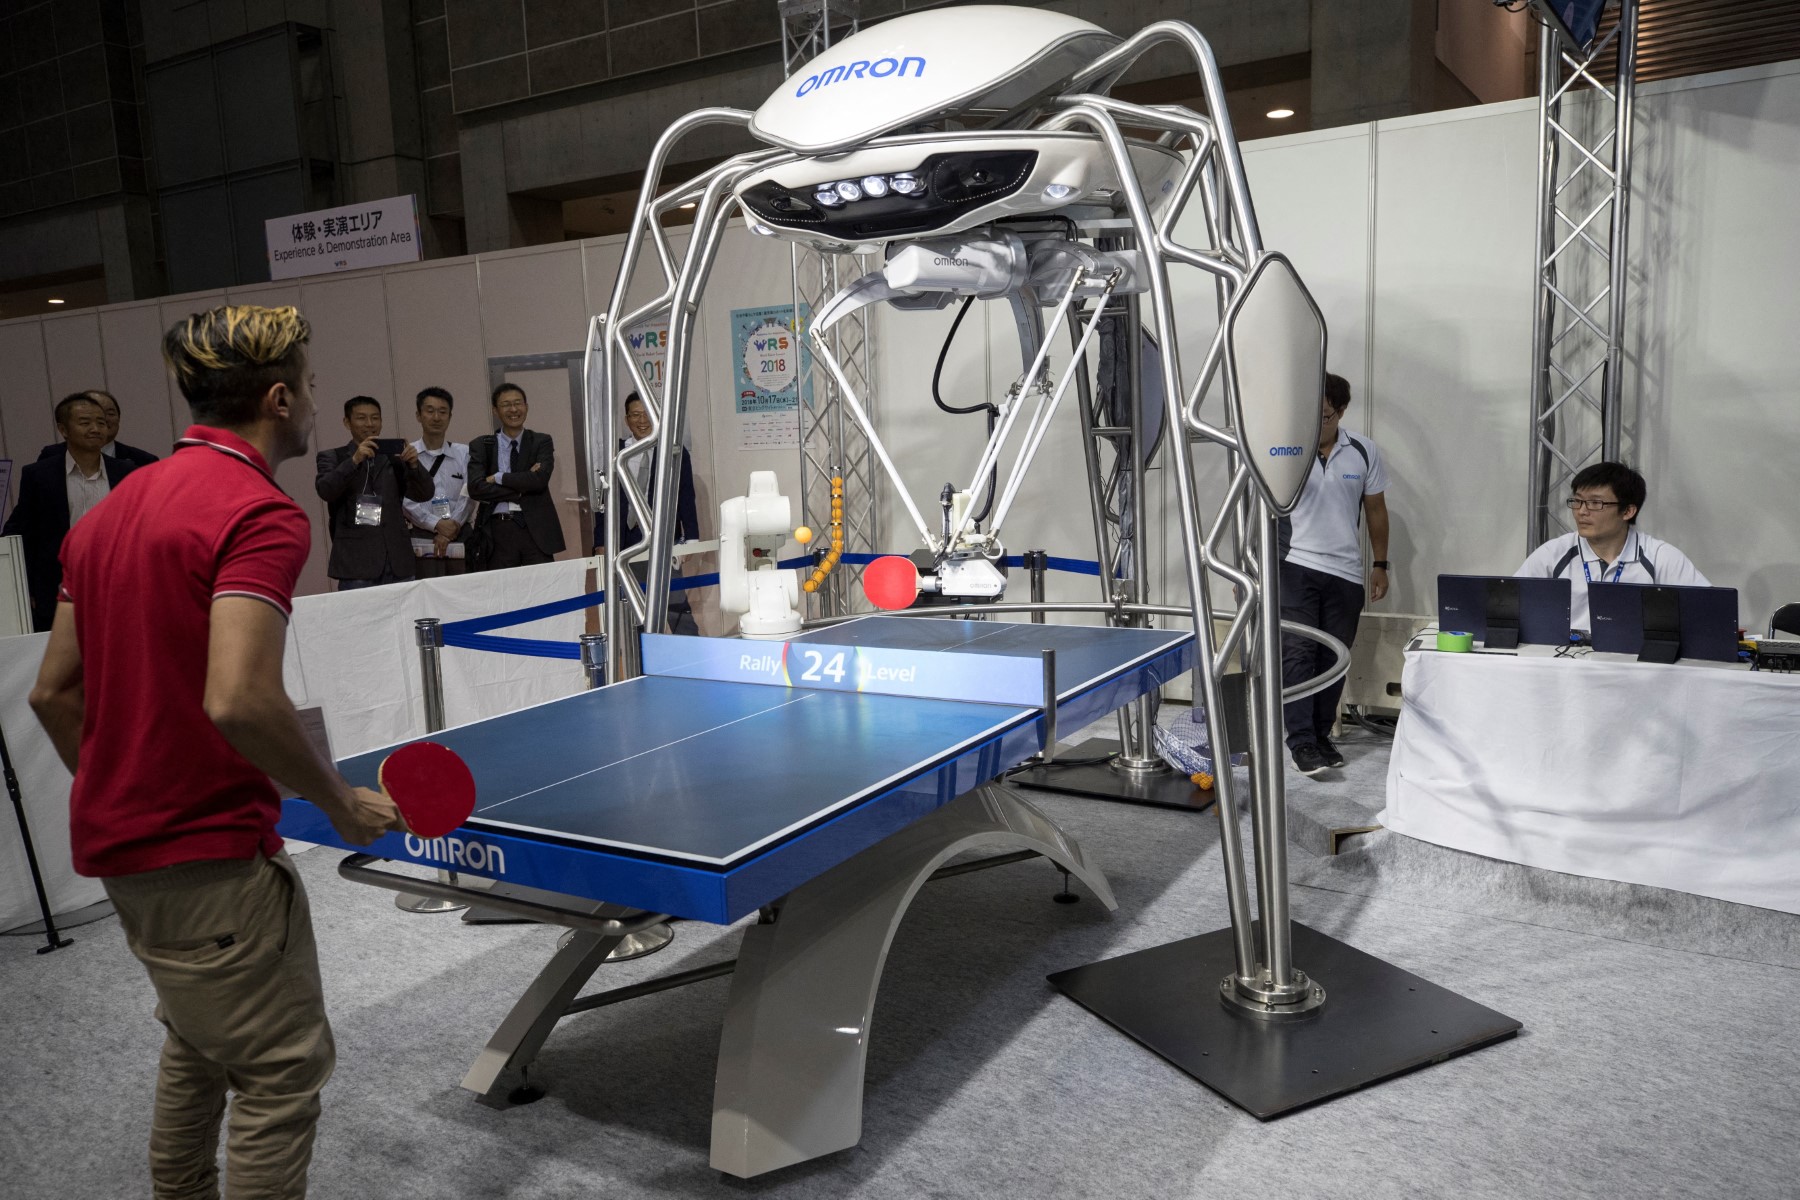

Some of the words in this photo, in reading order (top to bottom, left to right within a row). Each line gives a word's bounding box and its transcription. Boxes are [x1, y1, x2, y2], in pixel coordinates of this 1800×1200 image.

[796, 57, 926, 97] OMRON
[292, 211, 382, 243] 体験・実演エリア
[274, 247, 315, 262] Experience
[318, 244, 325, 255] &
[326, 235, 387, 253] Demonstration
[390, 231, 411, 244] Area
[934, 257, 968, 267] OMRON
[754, 337, 788, 351] WRS
[761, 359, 785, 372] 2018
[1270, 446, 1303, 457] OMRON
[740, 655, 781, 676] Rally
[801, 650, 846, 683] 24
[867, 664, 915, 682] Level
[404, 832, 506, 874] OMRON
